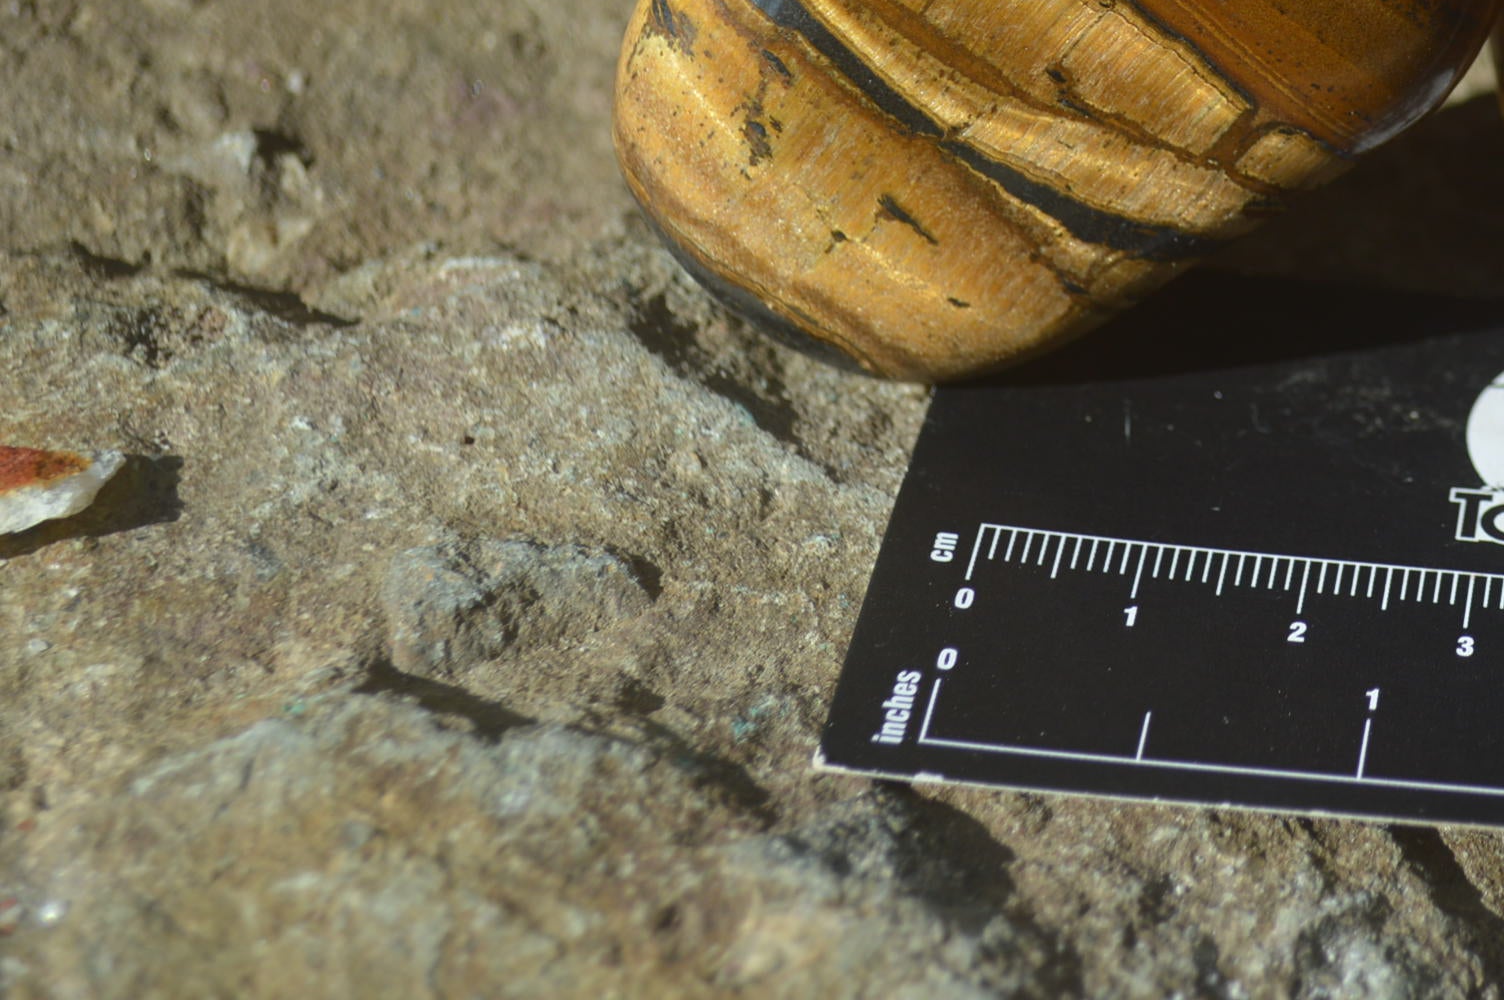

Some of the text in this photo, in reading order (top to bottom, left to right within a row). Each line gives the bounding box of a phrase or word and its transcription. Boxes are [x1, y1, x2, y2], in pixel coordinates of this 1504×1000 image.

[930, 531, 959, 563] cm
[954, 587, 975, 610] 0
[1123, 605, 1138, 627] 1
[1286, 621, 1308, 643] 2
[1455, 635, 1475, 657] 3
[871, 669, 922, 745] inches
[936, 647, 958, 671] 0
[1365, 687, 1380, 711] 1
